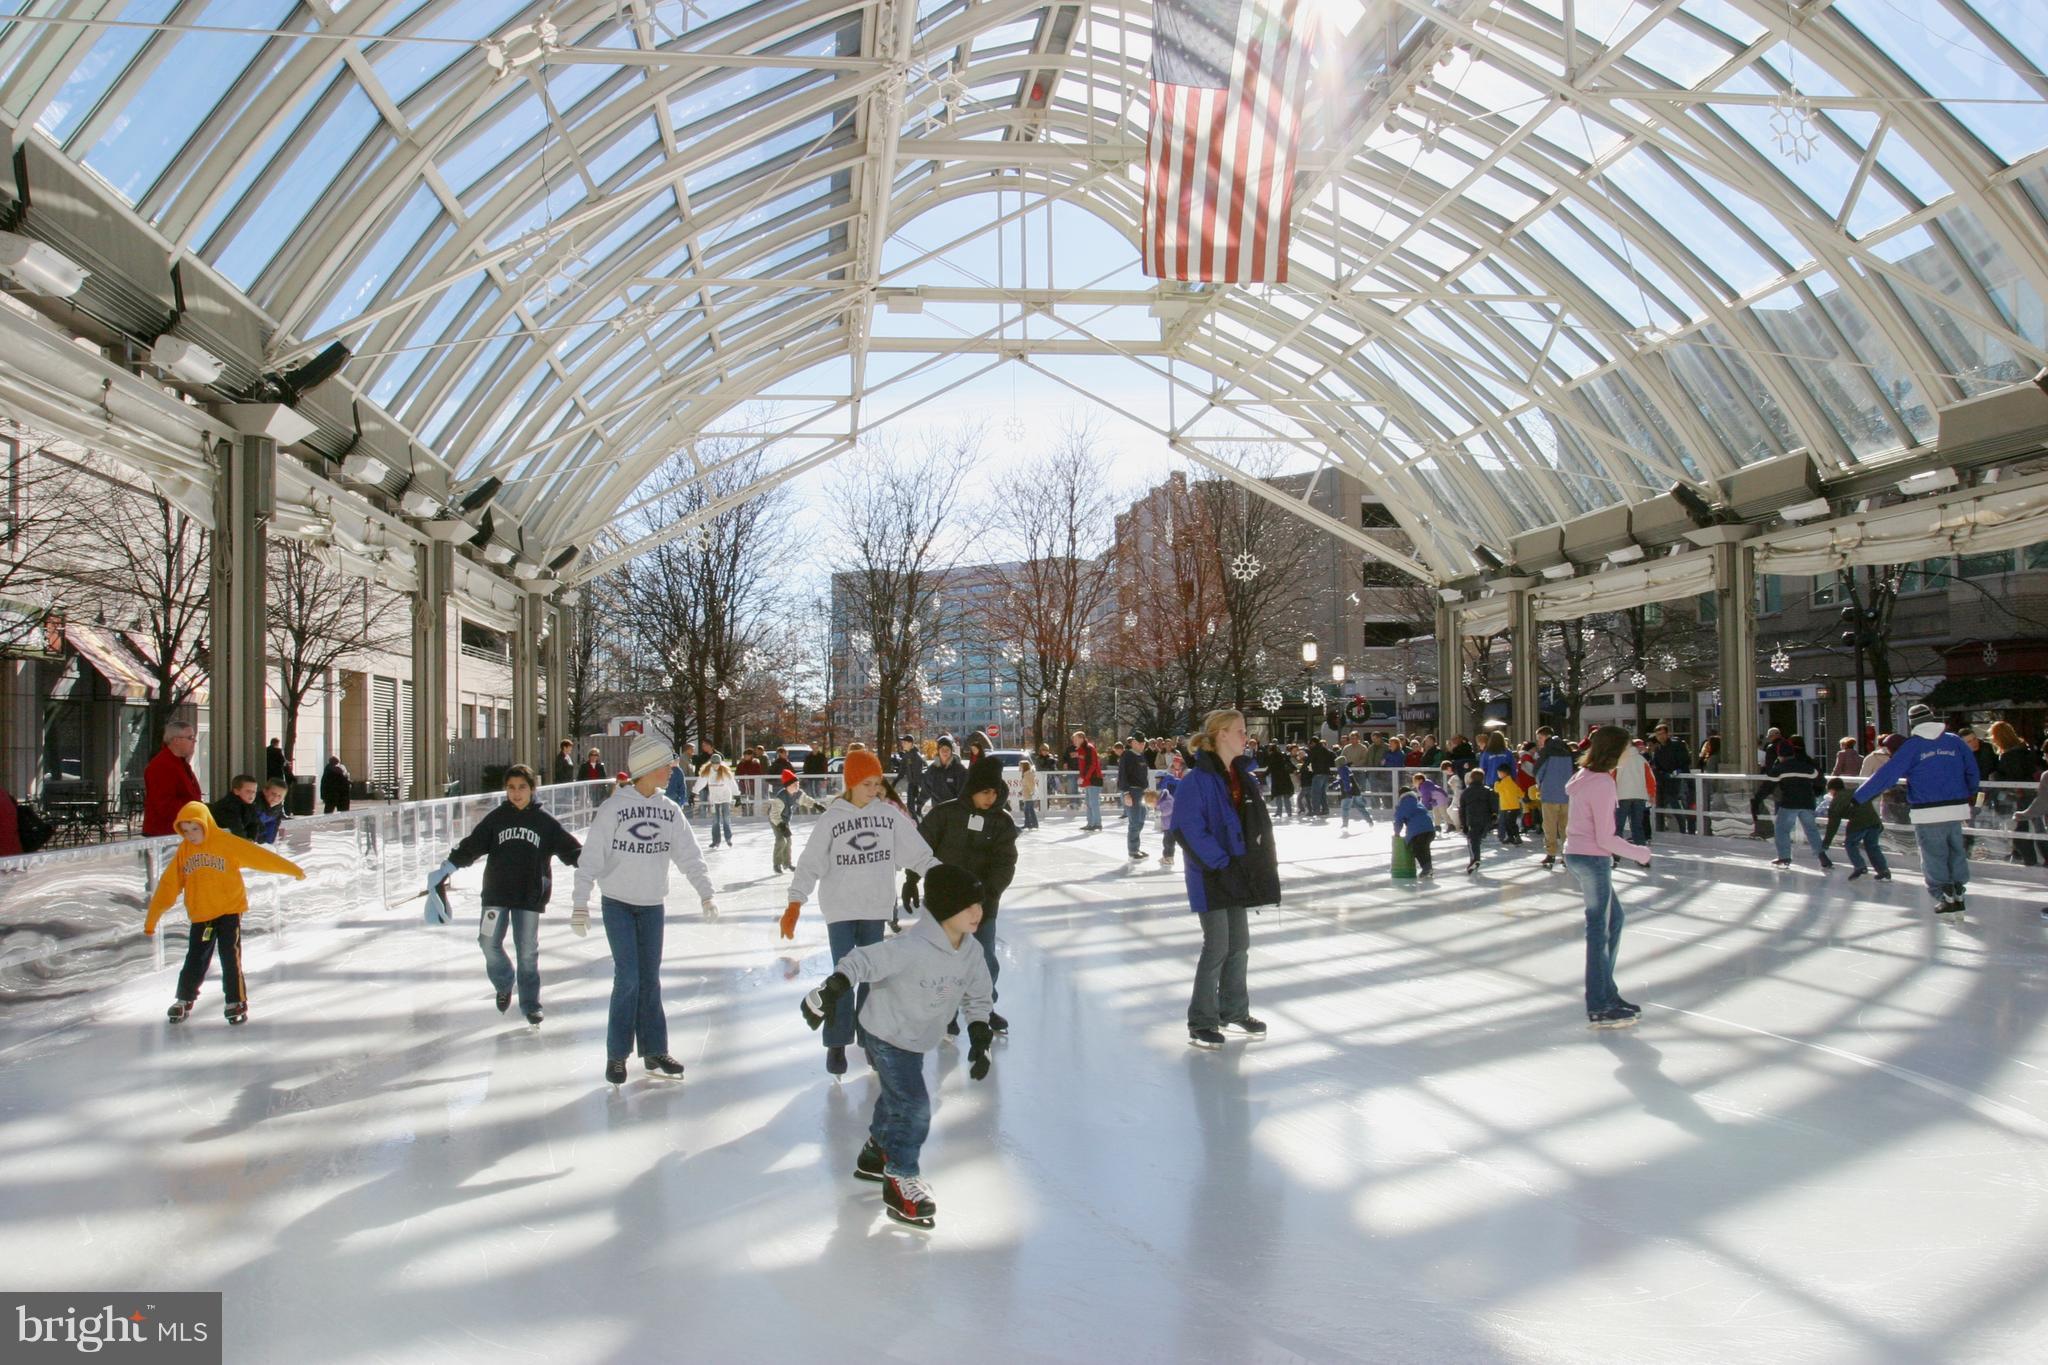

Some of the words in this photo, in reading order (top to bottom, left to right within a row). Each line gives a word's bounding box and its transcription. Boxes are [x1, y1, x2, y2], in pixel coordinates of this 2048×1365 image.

[617, 805, 675, 823] CHANTILLY
[832, 815, 894, 838] CHANTILLY
[498, 826, 541, 849] HOLTON
[836, 850, 891, 866] CHARGERS
